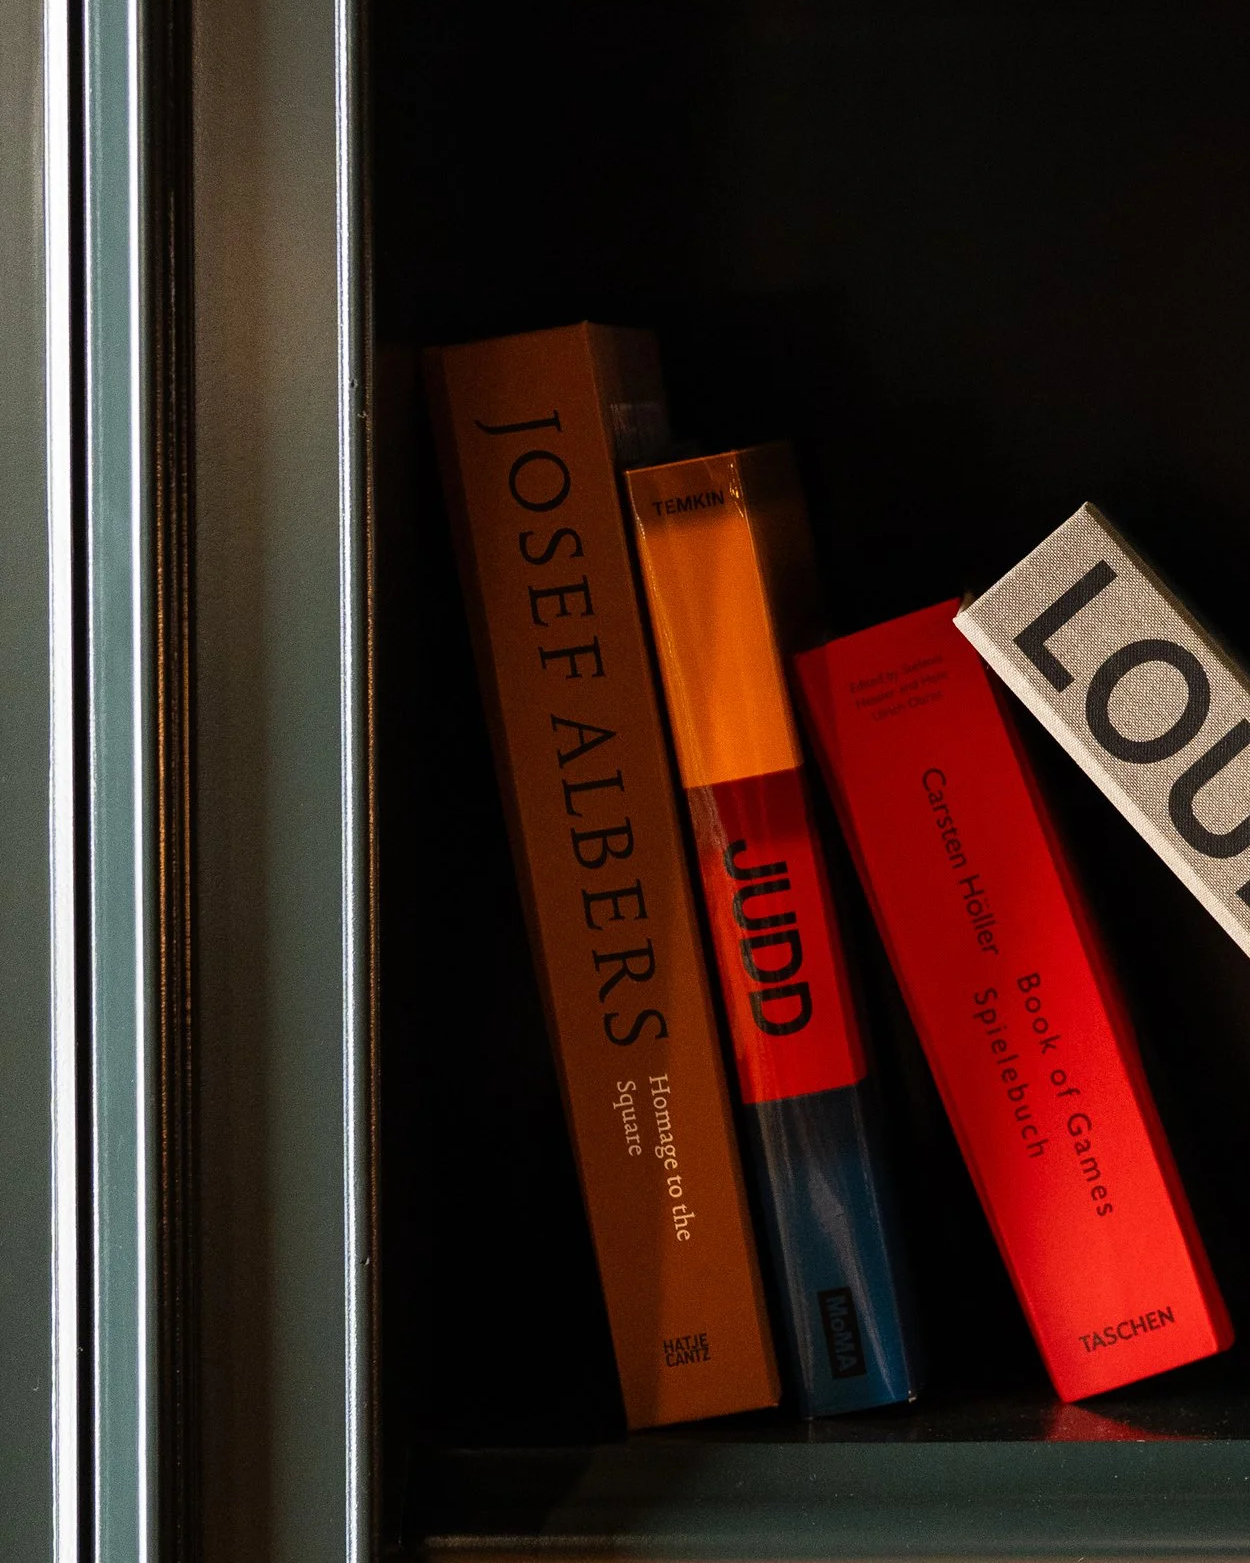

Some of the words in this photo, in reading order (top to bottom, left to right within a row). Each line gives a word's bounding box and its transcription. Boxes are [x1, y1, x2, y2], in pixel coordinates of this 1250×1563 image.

[652, 490, 725, 517] TEMKIN
[473, 409, 607, 679] JOSEF
[549, 713, 669, 1047] ALBERS
[921, 767, 969, 870] Carsten
[958, 873, 999, 956] Höller
[722, 841, 813, 1037] JUDD
[973, 988, 1045, 1159] Spielebuch
[1017, 972, 1062, 1055] Book
[1050, 1067, 1081, 1099] of
[1066, 1112, 1113, 1218] Games
[612, 1080, 643, 1157] Square
[648, 1073, 678, 1172] Homage
[667, 1173, 683, 1198] to
[672, 1203, 696, 1242] the
[663, 1333, 709, 1353] HATJE
[665, 1347, 711, 1368] CANTZ
[826, 1293, 859, 1373] MoMA
[1079, 1306, 1176, 1353] TASCHEN
